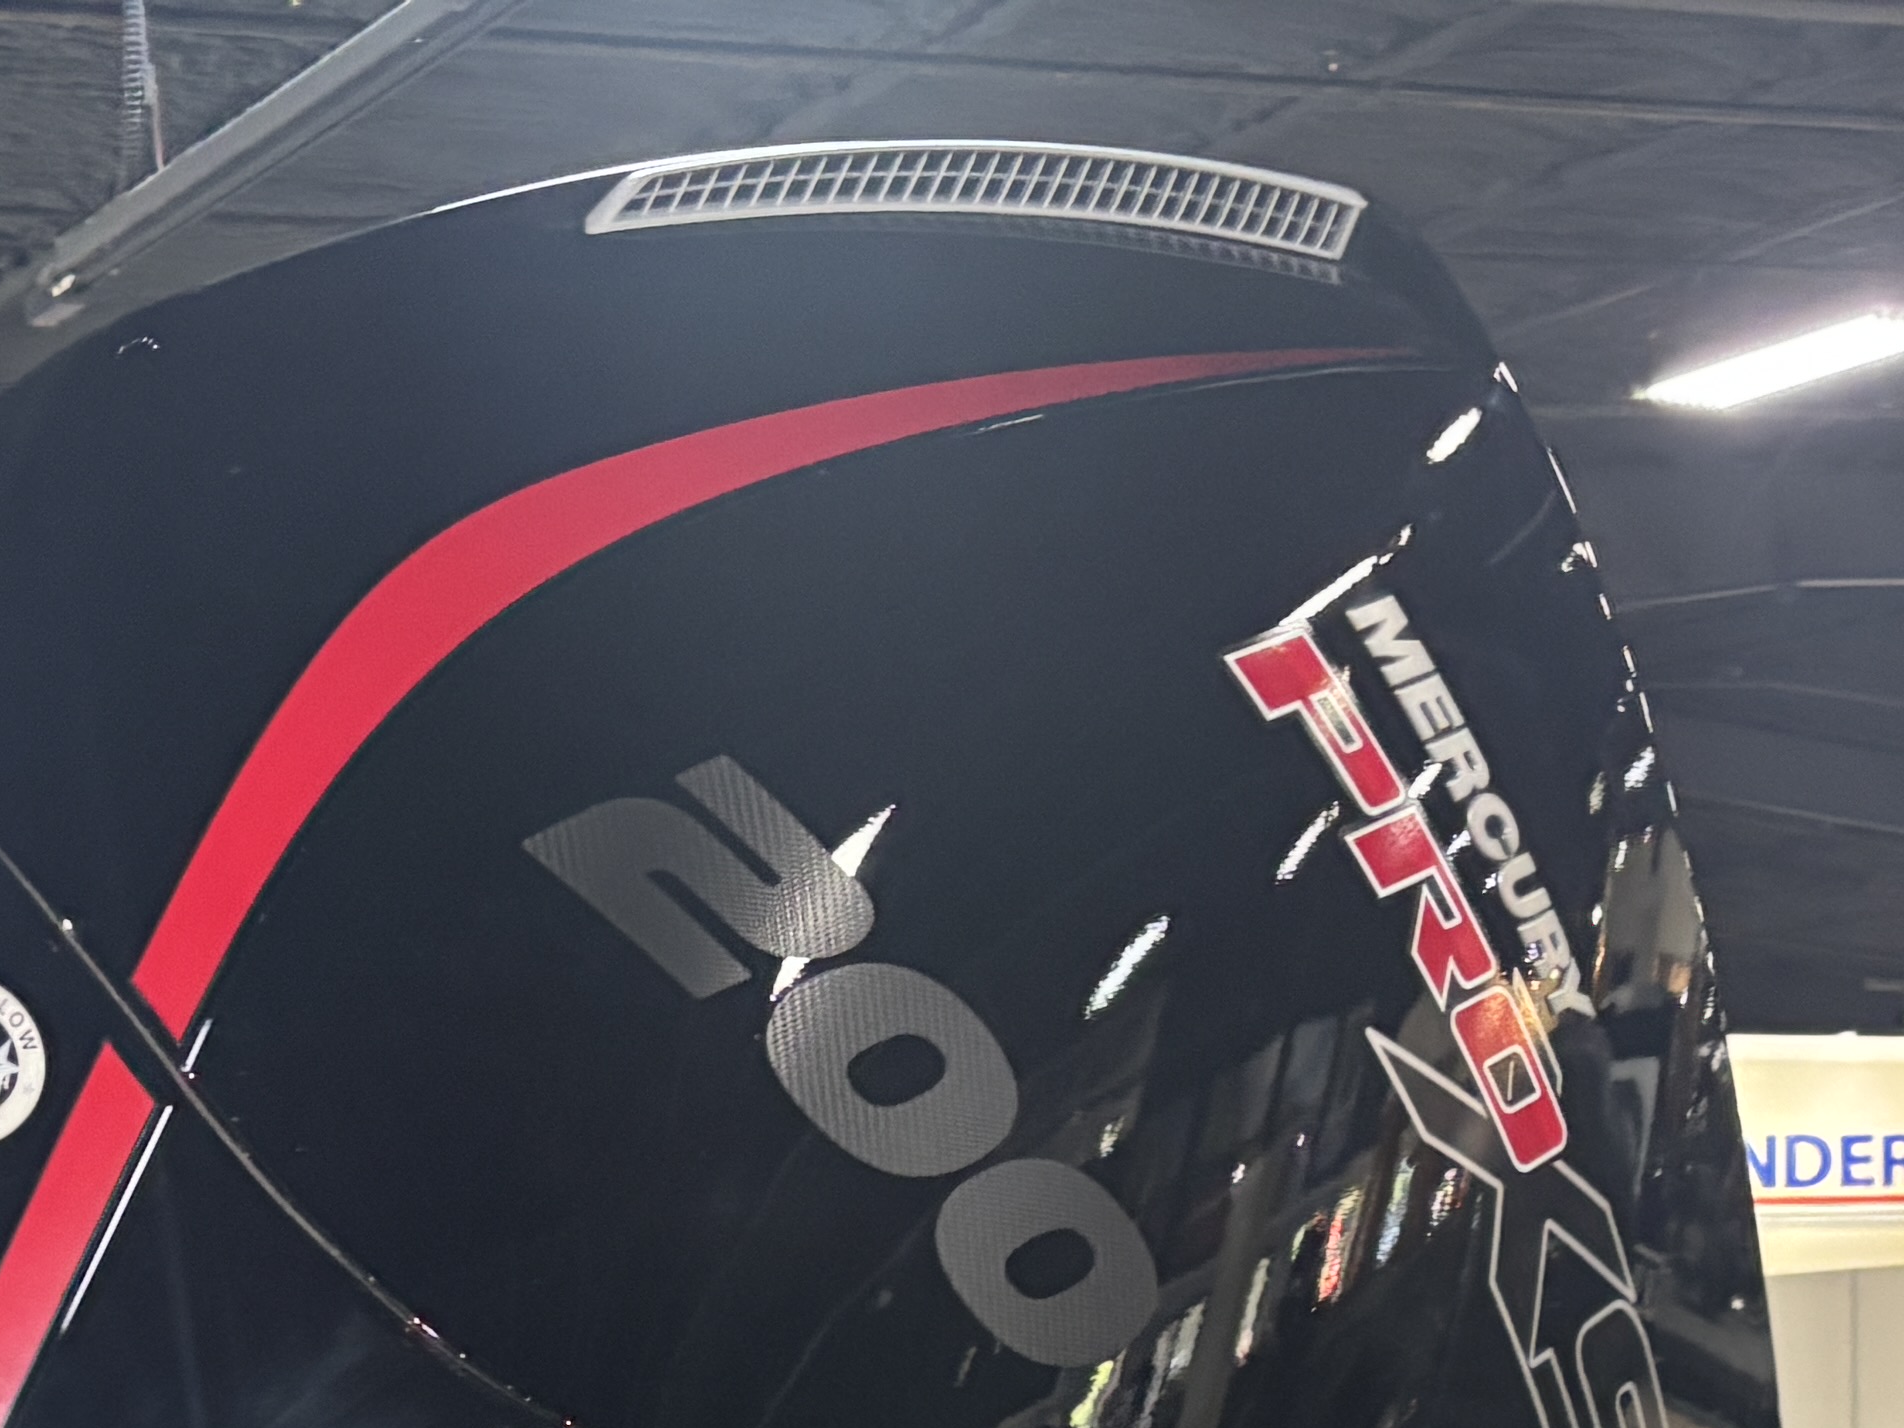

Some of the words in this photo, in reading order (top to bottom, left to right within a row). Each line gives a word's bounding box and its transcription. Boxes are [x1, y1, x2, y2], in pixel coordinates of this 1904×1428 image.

[521, 754, 1158, 1368] 200
[1224, 630, 1568, 1172] PRO
[1345, 595, 1596, 1018] MERCURY
